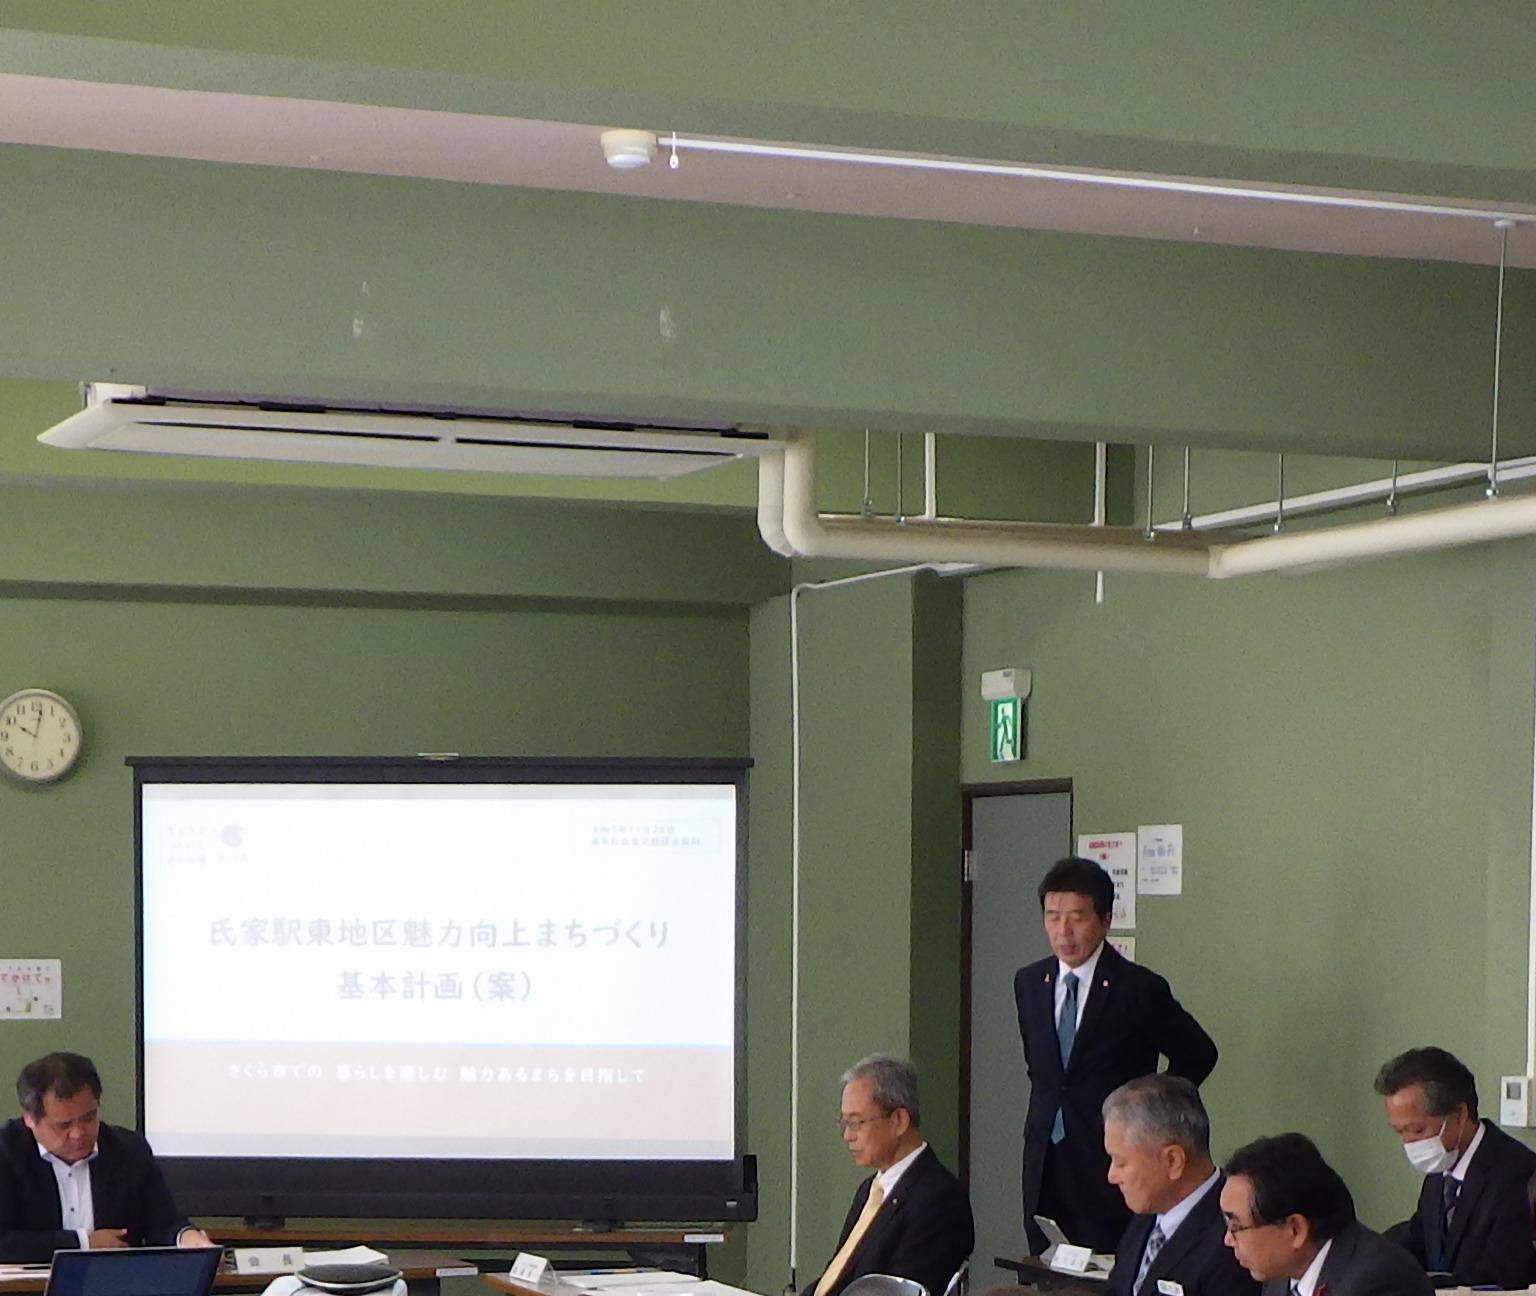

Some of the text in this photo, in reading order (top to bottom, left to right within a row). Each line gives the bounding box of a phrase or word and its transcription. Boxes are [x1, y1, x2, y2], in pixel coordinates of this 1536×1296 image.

[209, 918, 670, 949] 氏家駅東地区魅力向上まちづくり
